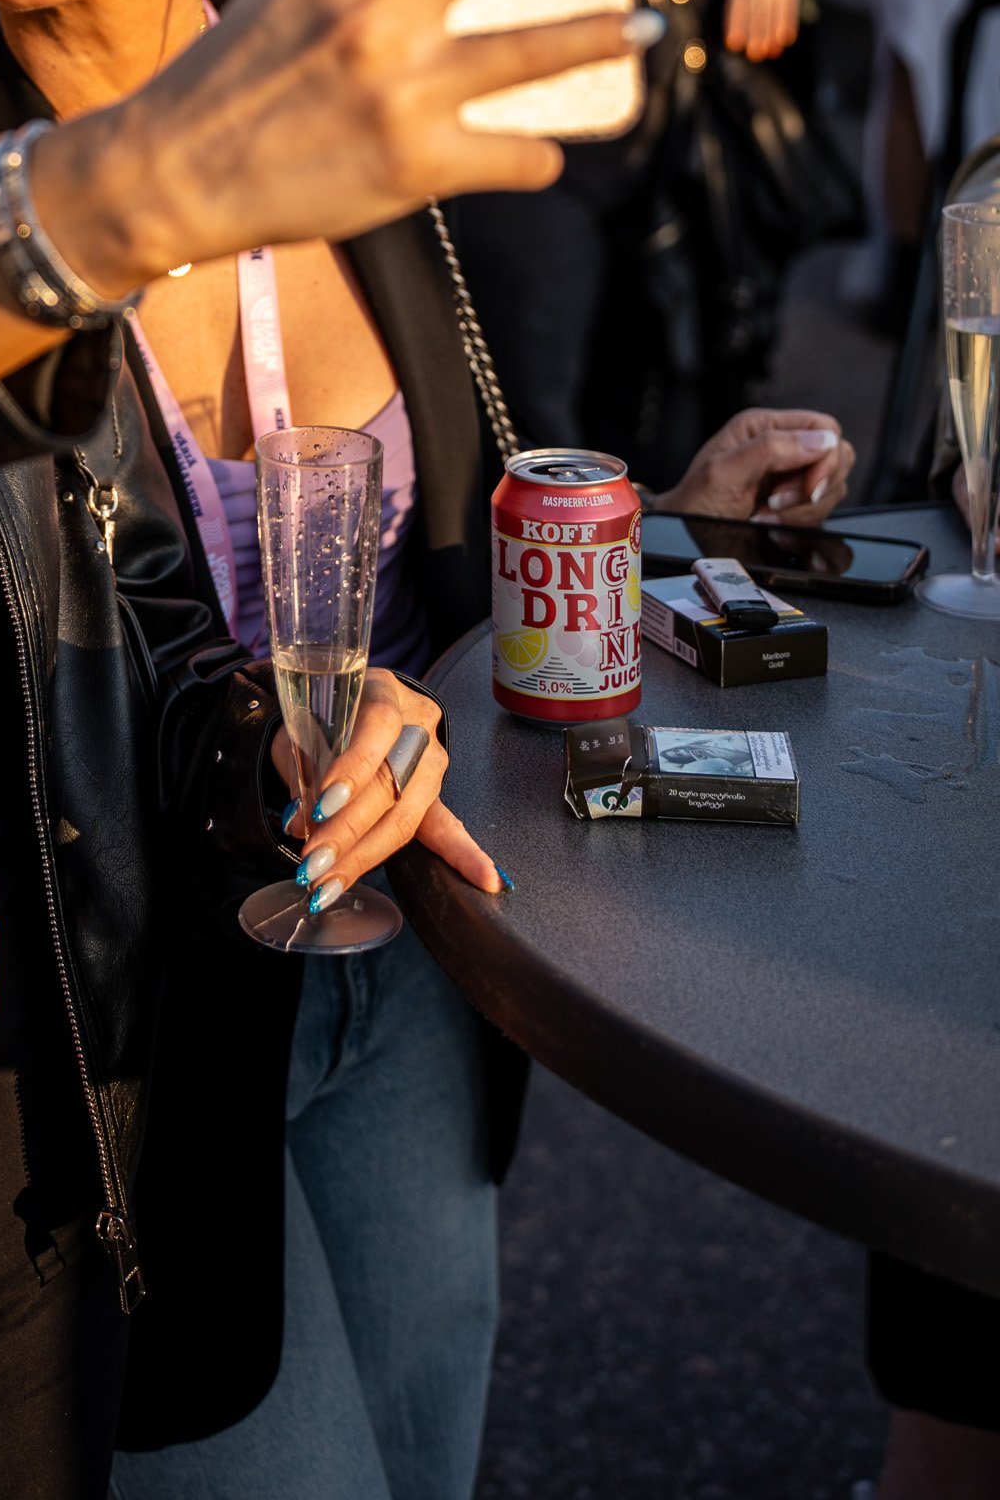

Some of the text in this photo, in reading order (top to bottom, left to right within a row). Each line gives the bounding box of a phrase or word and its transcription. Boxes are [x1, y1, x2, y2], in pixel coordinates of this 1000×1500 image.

[542, 493, 614, 508] RASPBERRY-LEMON
[521, 519, 597, 544] KOFF
[498, 537, 629, 591] LONG
[762, 651, 790, 661] Marlboro
[768, 660, 784, 669] Gold
[538, 680, 572, 694] 5,0%
